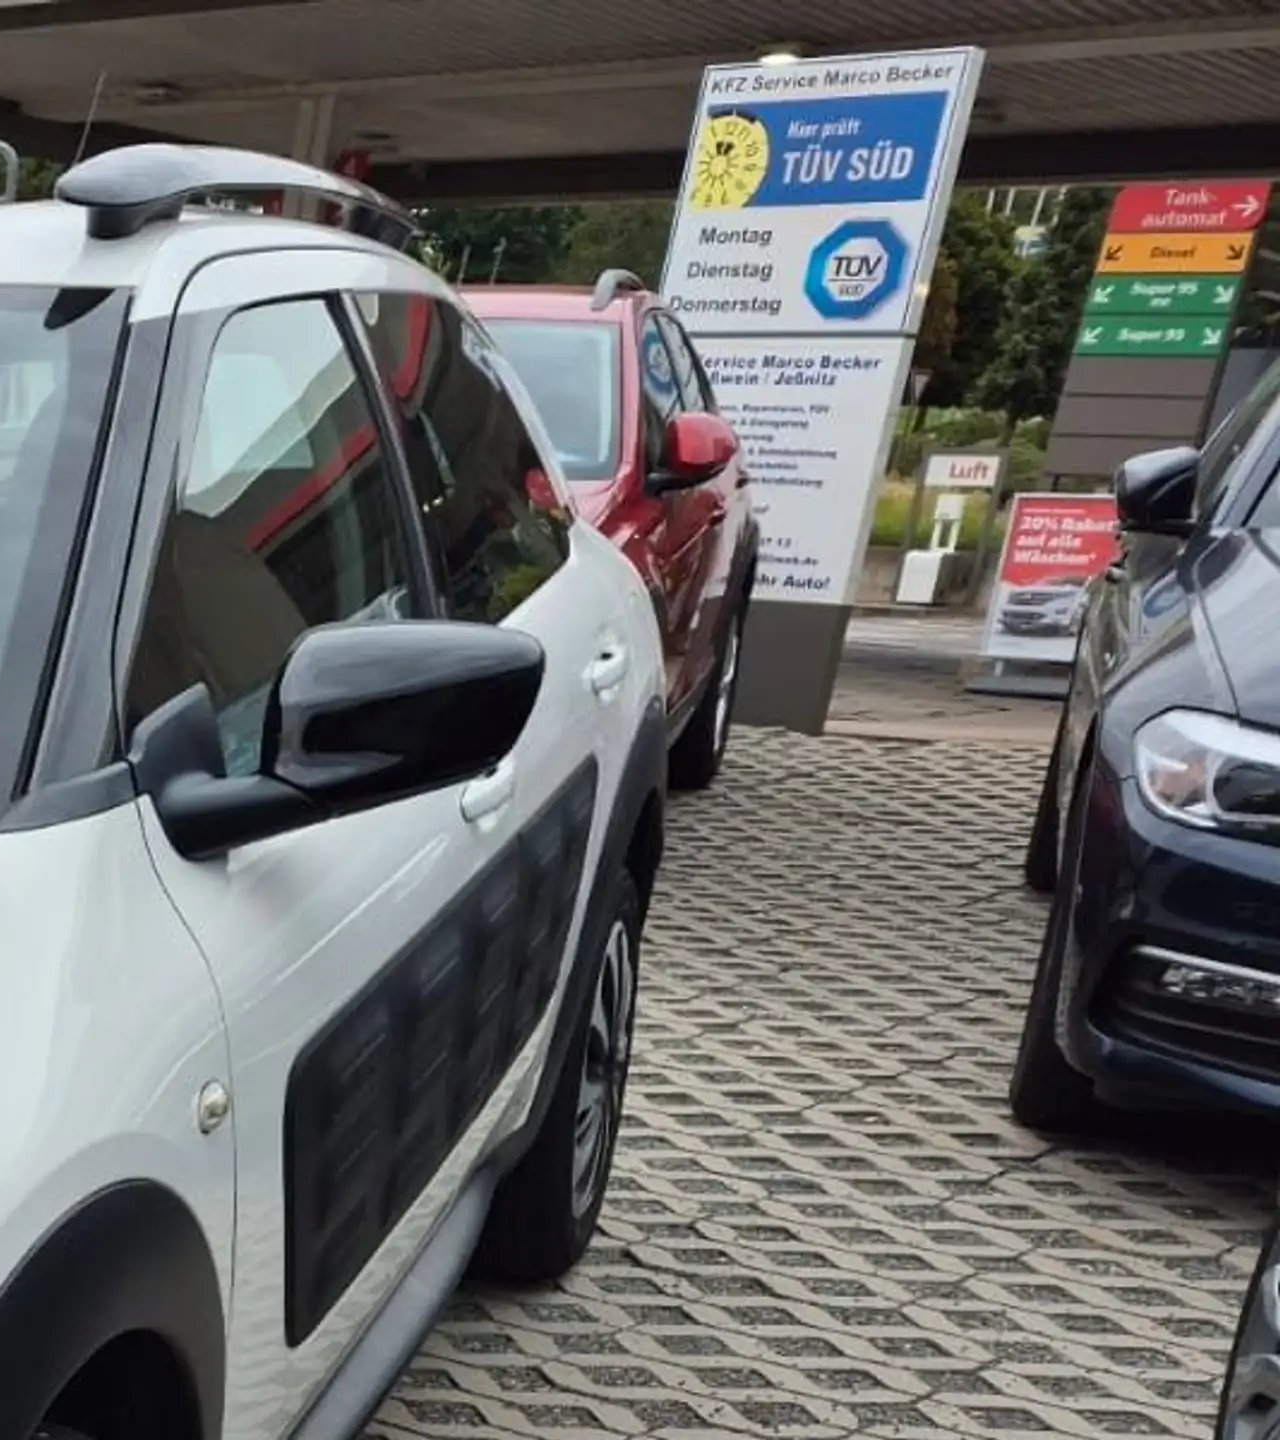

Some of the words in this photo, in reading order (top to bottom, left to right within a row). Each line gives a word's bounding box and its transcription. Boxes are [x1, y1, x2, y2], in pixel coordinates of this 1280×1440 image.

[711, 77, 747, 93] KFZ
[752, 73, 817, 91] Service
[824, 67, 880, 87] Marco
[886, 63, 954, 82] Becker
[822, 116, 861, 140] prüft
[783, 144, 843, 184] TÜV
[846, 139, 914, 181] SÜD
[1141, 209, 1227, 228] automat
[699, 227, 772, 247] Montag
[687, 261, 773, 282] Dienstag
[1128, 280, 1176, 297] Super
[670, 296, 782, 316] Donnerstag
[1117, 328, 1163, 343] Super
[697, 354, 757, 369] ervice
[761, 354, 815, 369] Marco
[819, 355, 883, 370] Becker
[949, 460, 989, 480] Luft
[782, 575, 831, 590] Auto!
